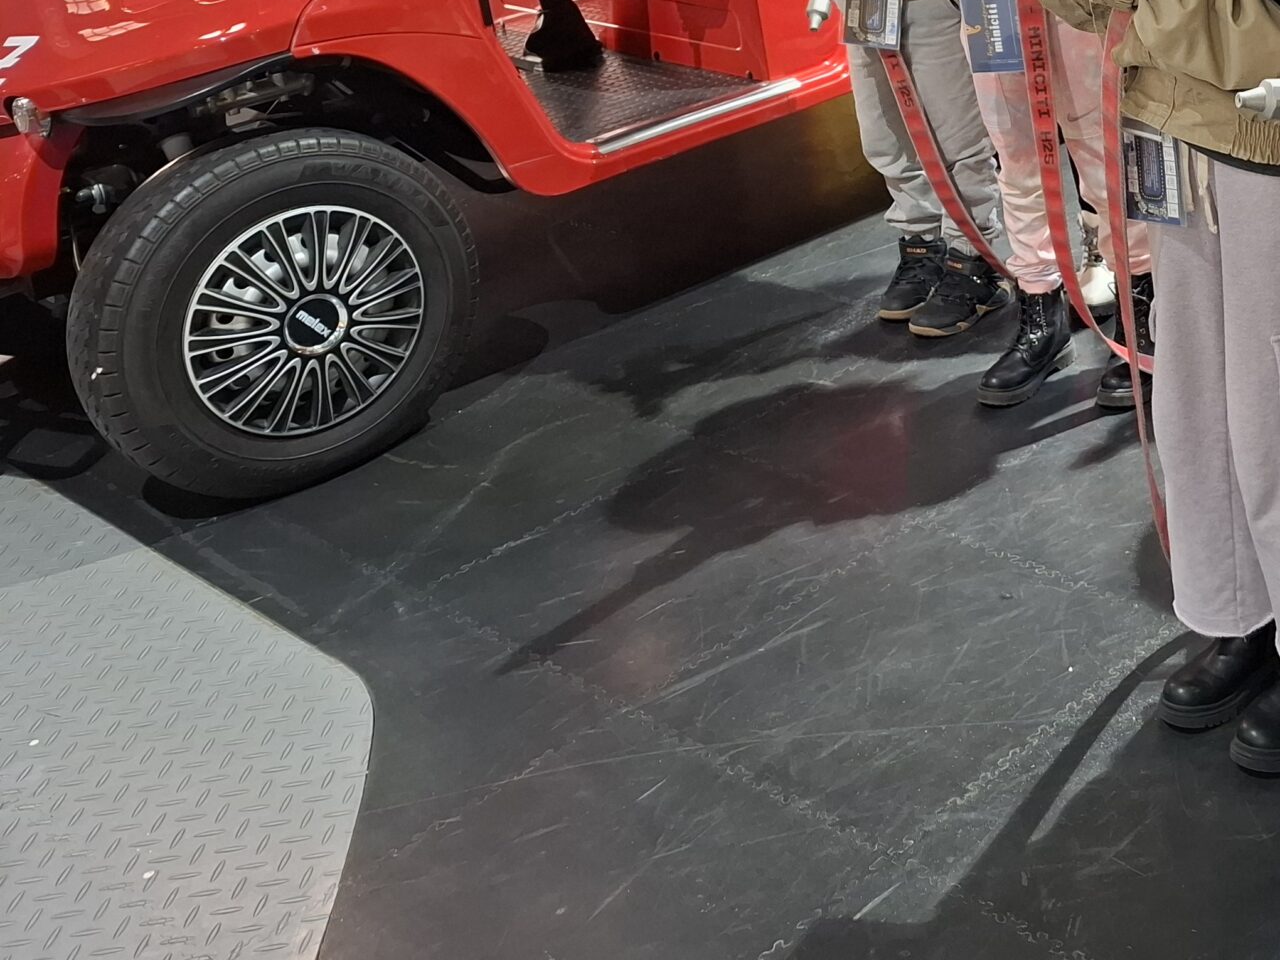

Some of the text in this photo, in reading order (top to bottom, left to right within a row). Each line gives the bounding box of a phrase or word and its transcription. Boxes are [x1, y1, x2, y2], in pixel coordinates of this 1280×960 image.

[985, 3, 1004, 53] miniciti
[1027, 26, 1051, 119] MINICITI
[1040, 131, 1054, 165] H25
[295, 310, 332, 338] melex
